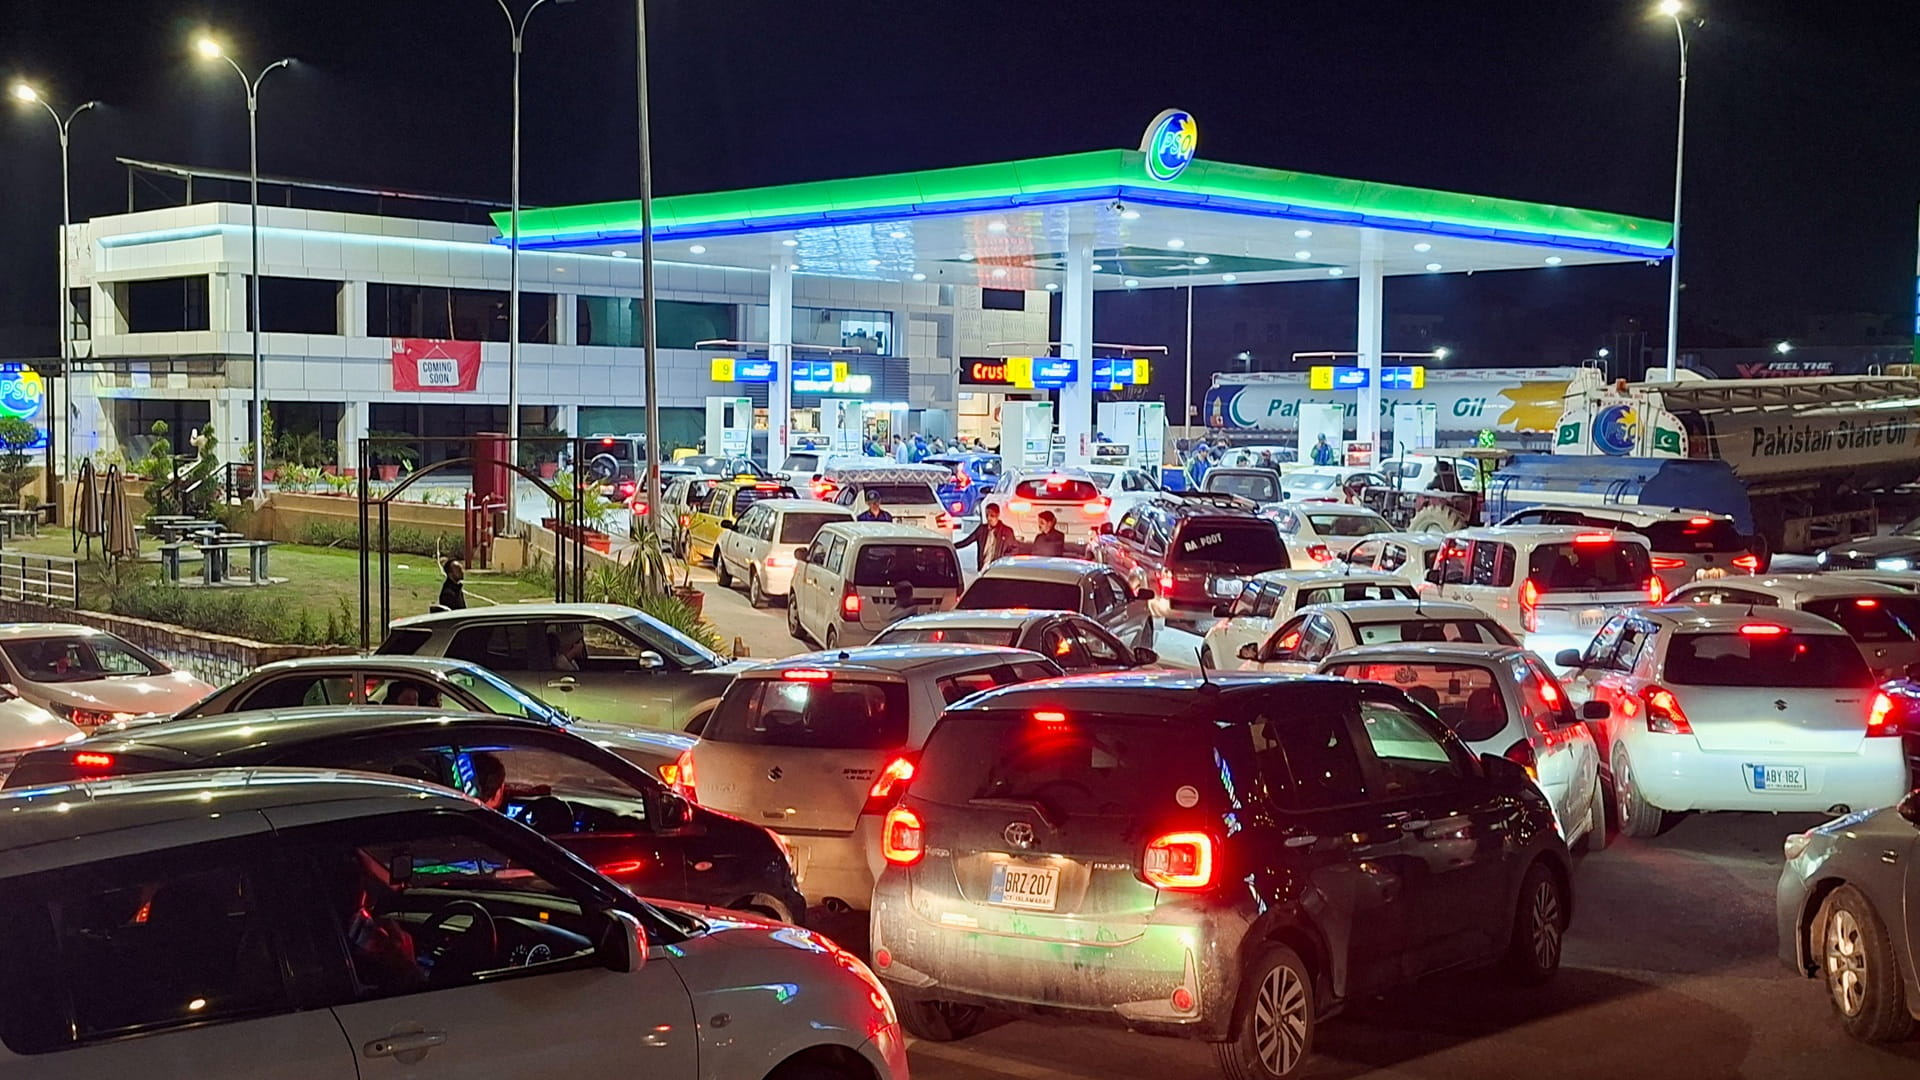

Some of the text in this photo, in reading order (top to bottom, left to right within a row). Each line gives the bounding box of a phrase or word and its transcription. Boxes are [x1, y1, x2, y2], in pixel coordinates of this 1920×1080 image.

[1160, 131, 1192, 156] PSO
[423, 361, 452, 373] COMING
[722, 364, 730, 376] 9
[1137, 365, 1143, 378] 3
[1768, 362, 1832, 370] FEEL THE
[429, 373, 450, 384] SOON
[835, 367, 844, 380] 11
[0, 380, 38, 401] PSO
[1453, 397, 1486, 418] Oil
[1752, 416, 1907, 457] Pakistan State Oil
[1766, 770, 1799, 783] ABY 182
[1005, 872, 1053, 896] BRZ 207
